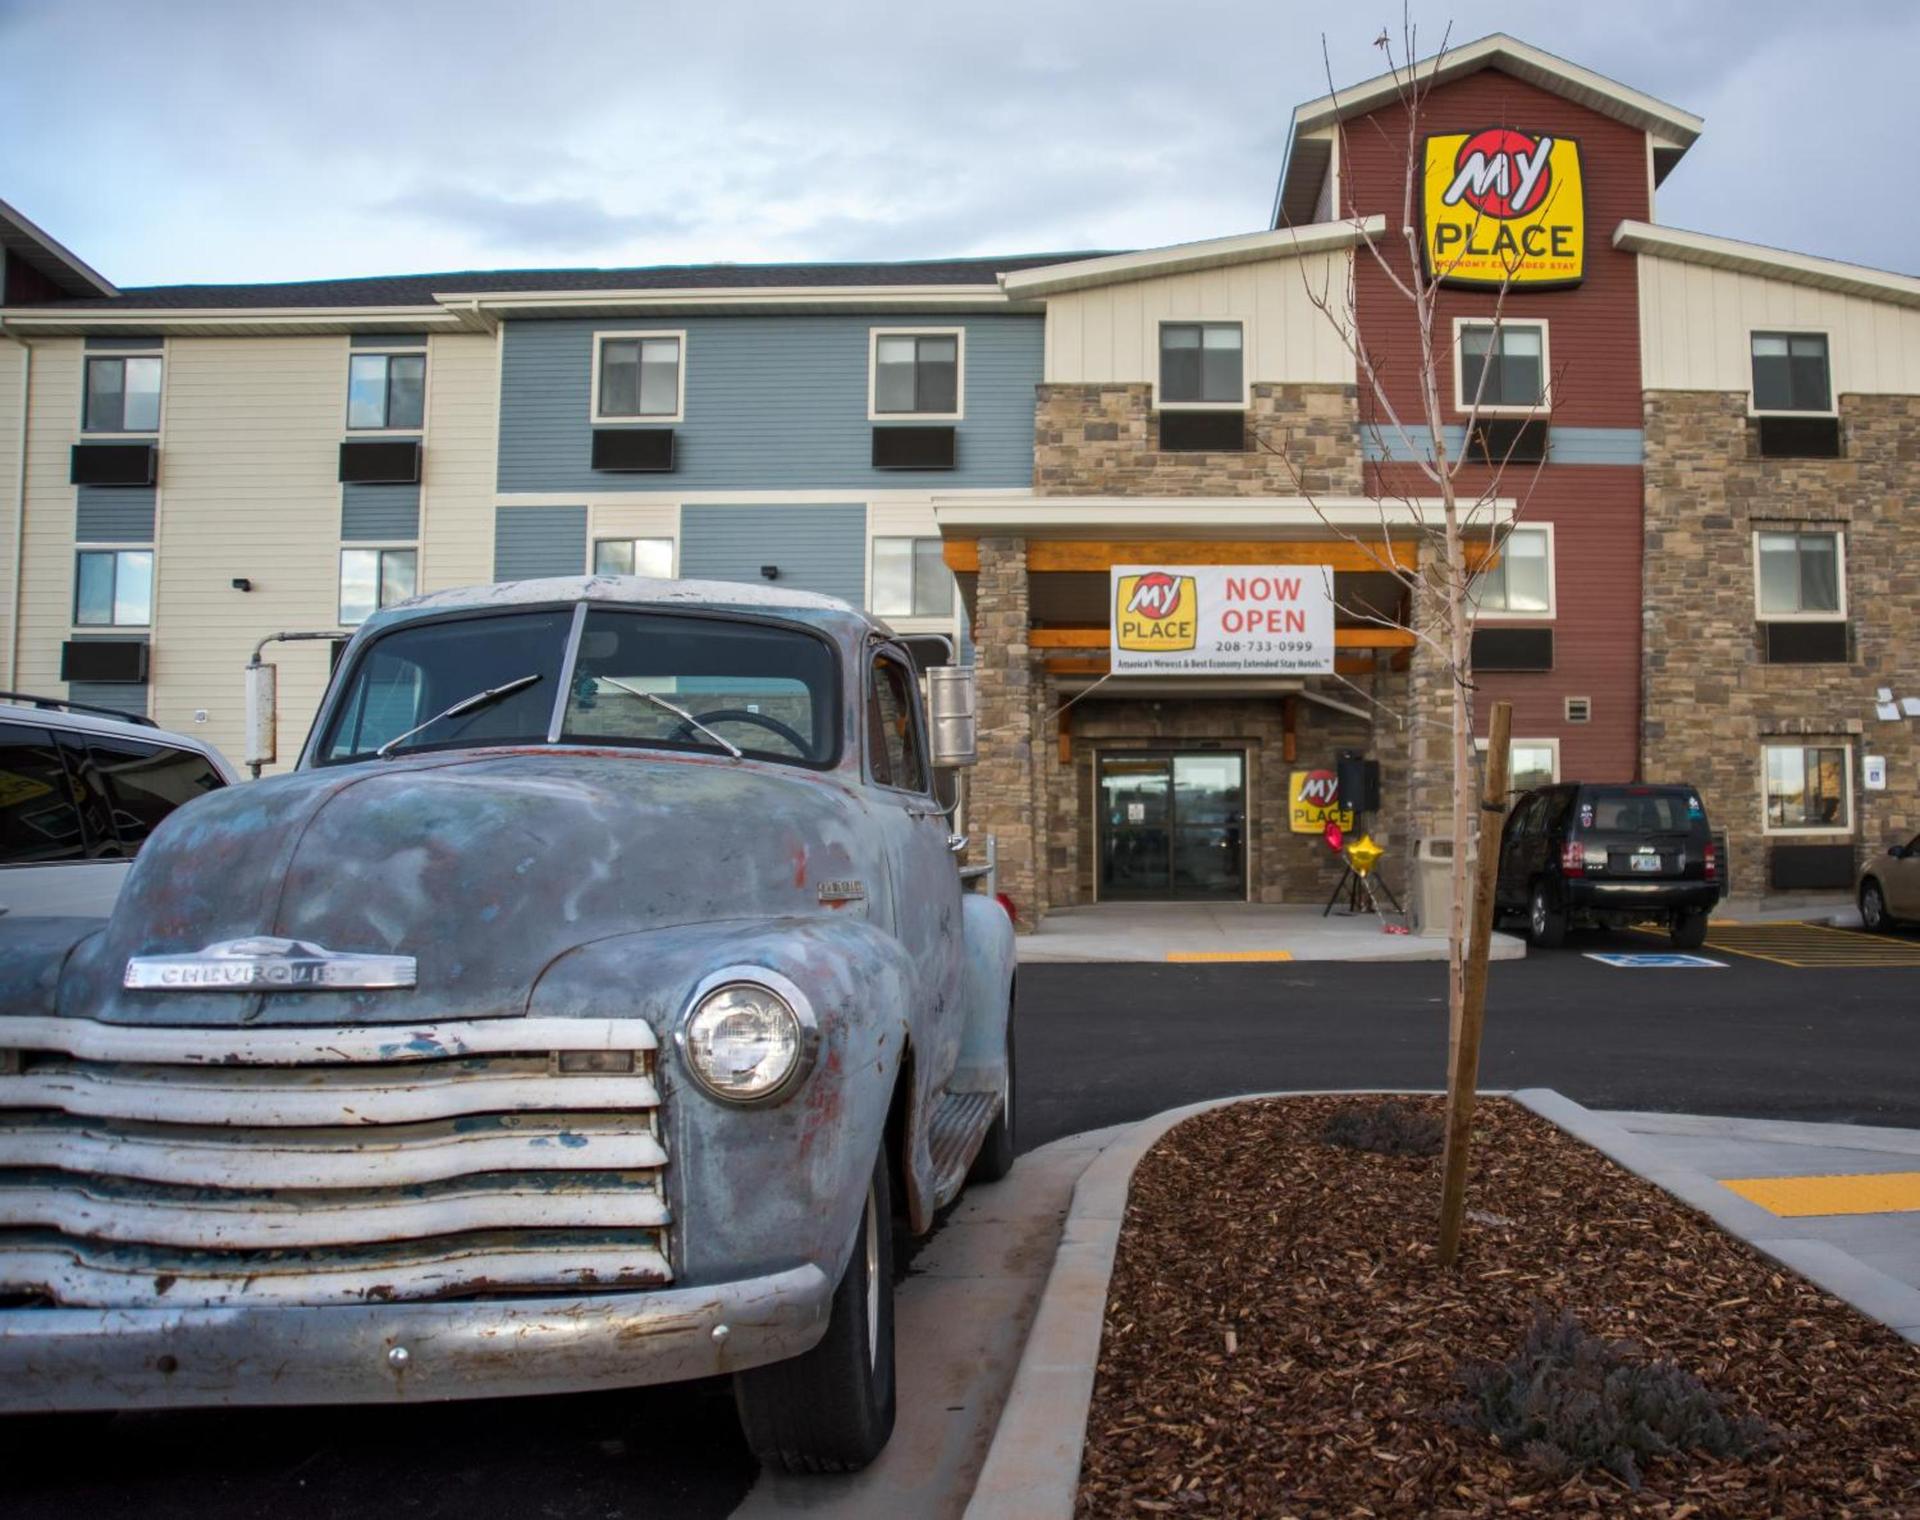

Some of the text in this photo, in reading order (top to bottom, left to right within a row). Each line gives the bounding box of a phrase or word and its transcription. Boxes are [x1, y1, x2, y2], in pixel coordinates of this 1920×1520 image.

[1436, 223, 1575, 257] PLACE
[1226, 577, 1301, 601] NOW
[1123, 621, 1191, 638] PLACE
[1221, 609, 1305, 633] OPEN
[1216, 640, 1313, 652] 208-733-0999
[1154, 659, 1182, 669] Newest
[1191, 659, 1207, 669] Best
[1209, 659, 1242, 670] Economy
[1243, 659, 1279, 669] Extended
[1280, 659, 1296, 670] Stay
[1294, 809, 1350, 823] PLACE
[160, 962, 362, 985] CHEVROLET
